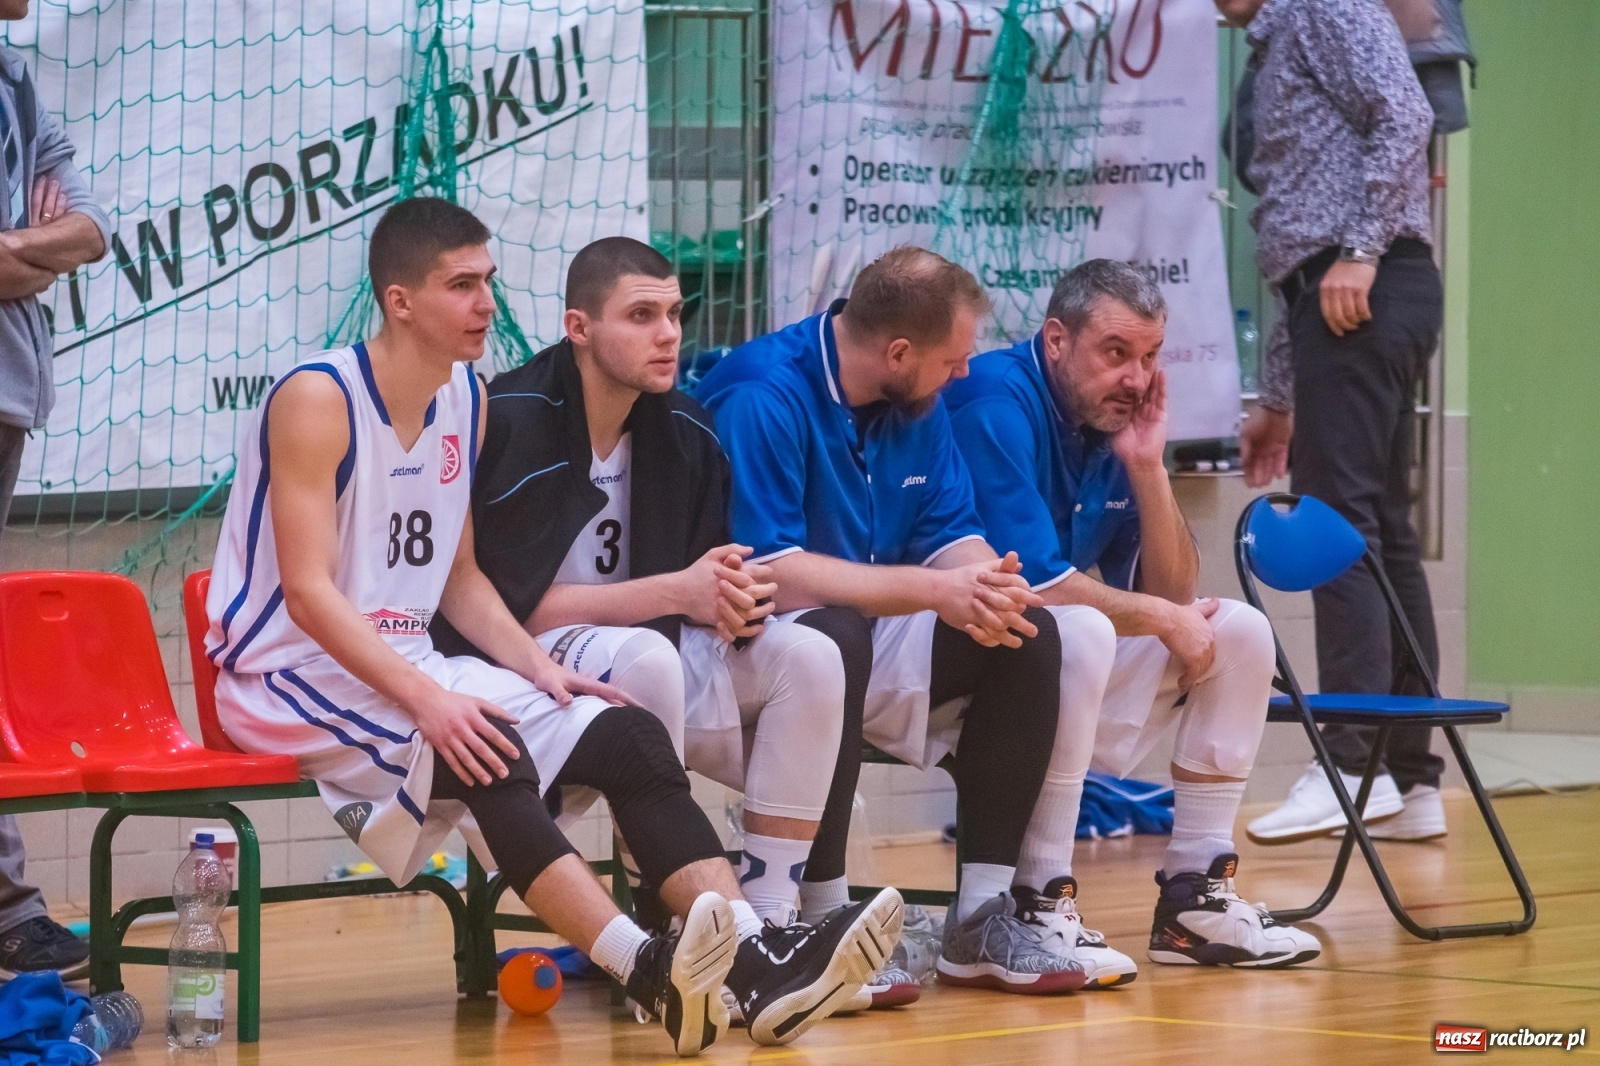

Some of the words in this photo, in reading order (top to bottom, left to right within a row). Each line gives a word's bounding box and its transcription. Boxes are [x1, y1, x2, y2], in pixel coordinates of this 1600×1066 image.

[845, 196, 957, 228] Pracown
[110, 206, 184, 305] W
[595, 519, 621, 575] 3
